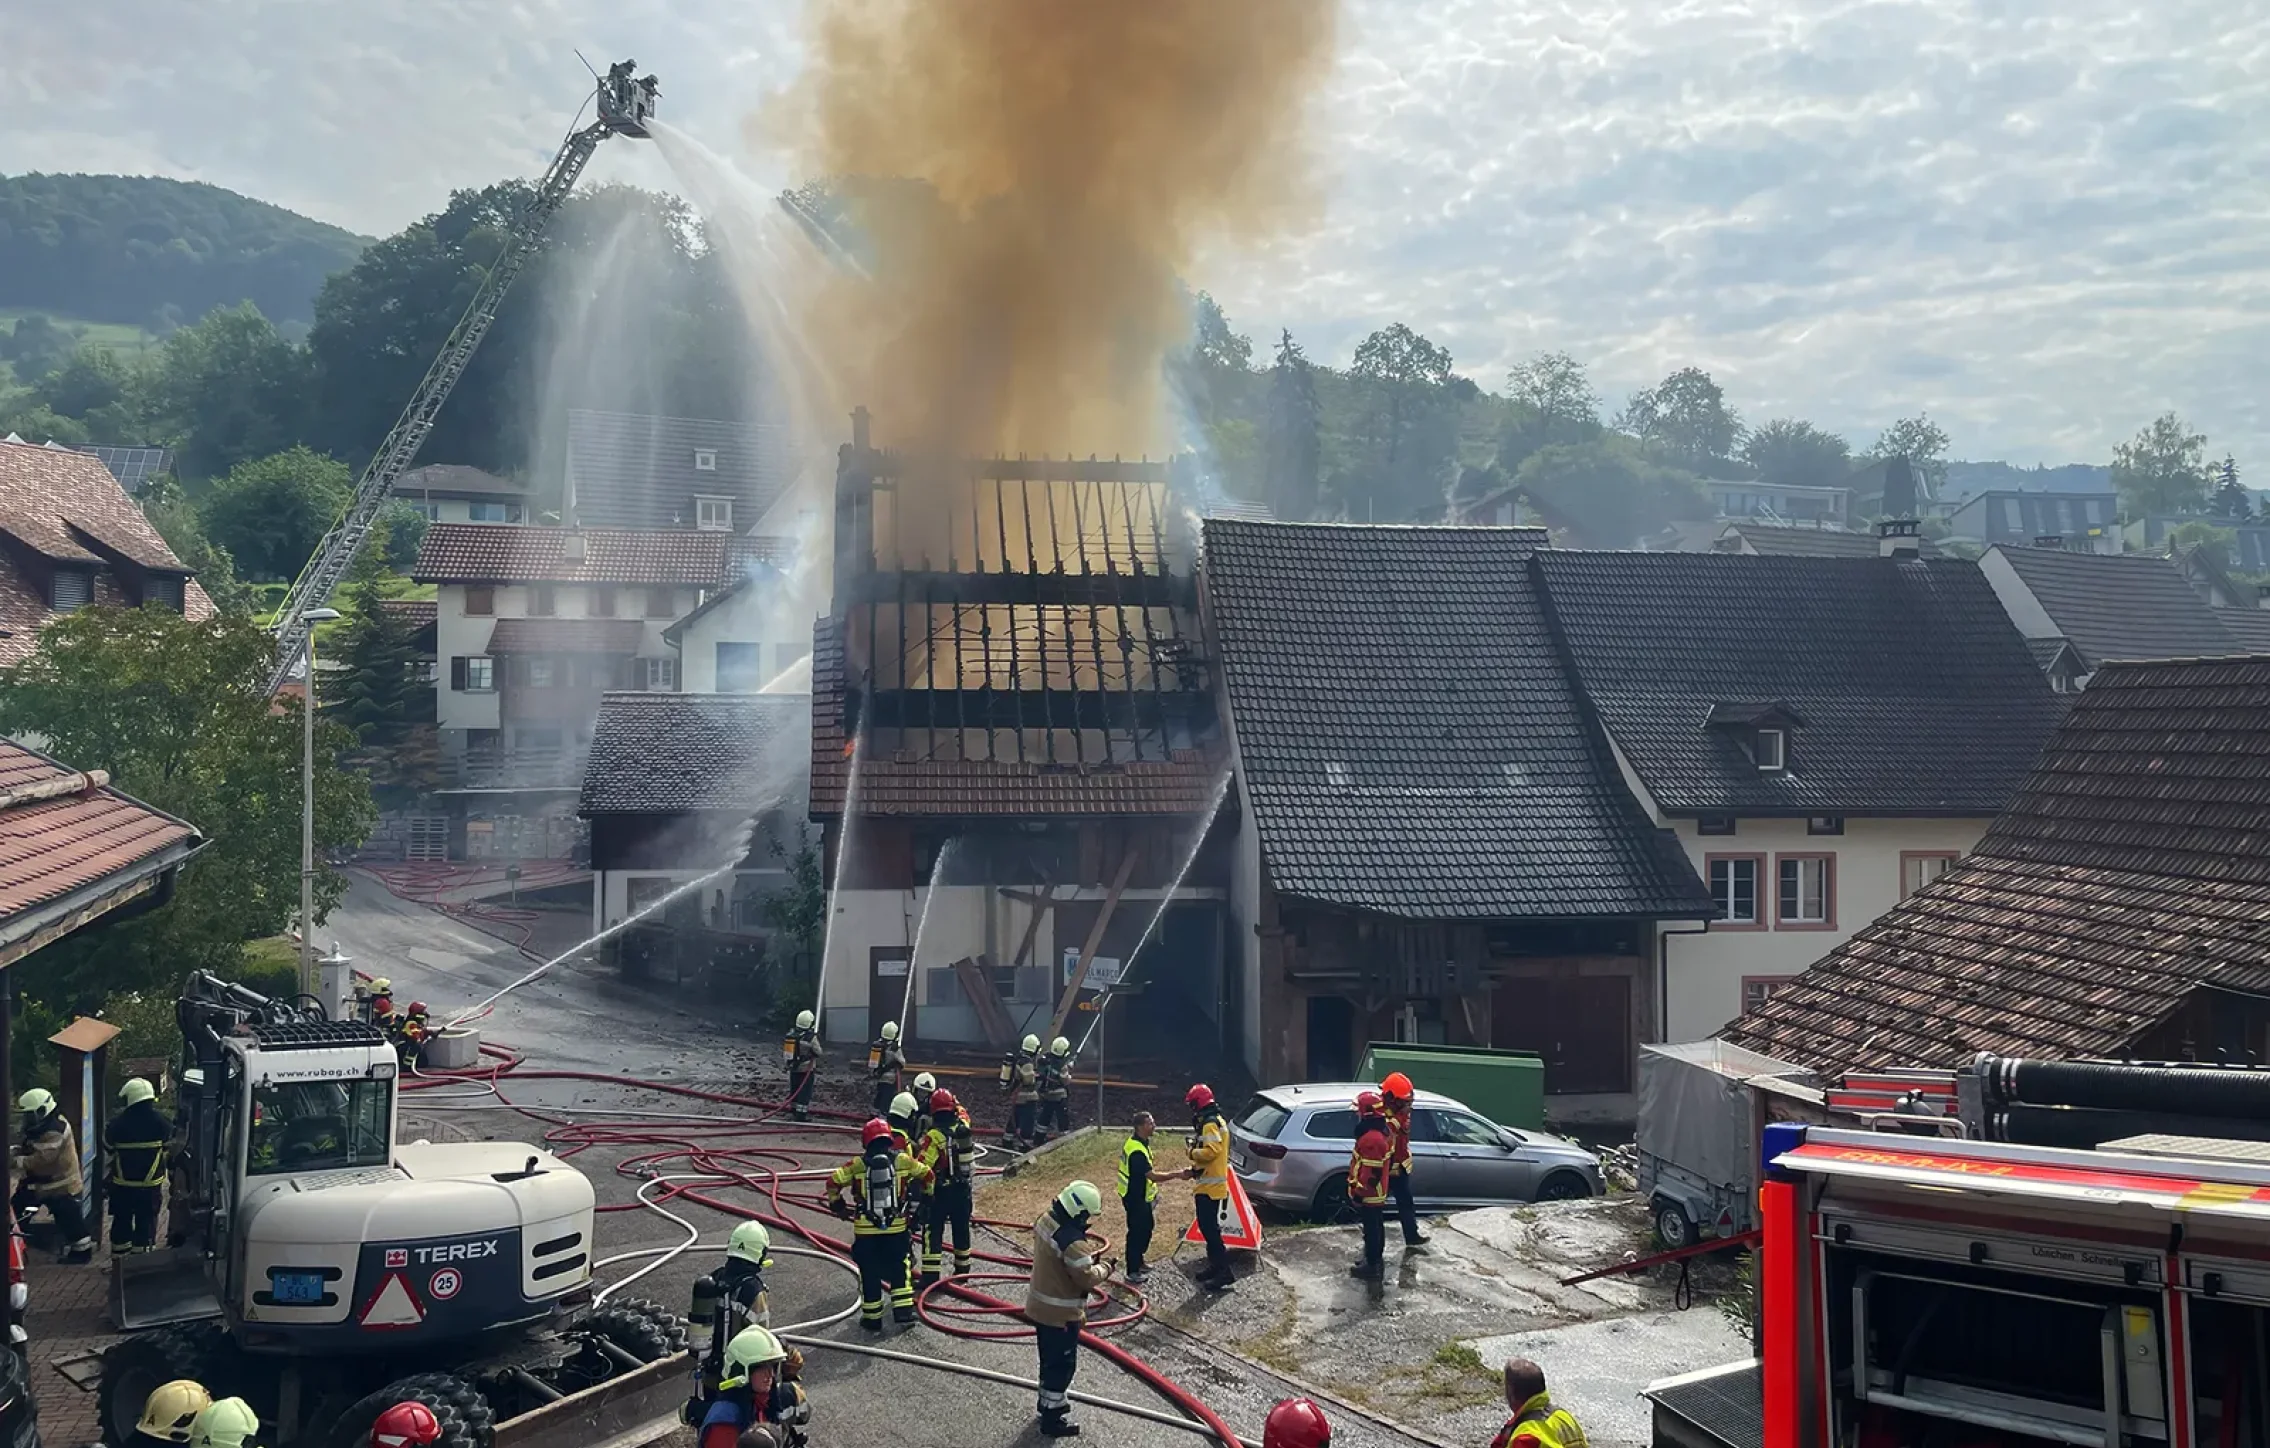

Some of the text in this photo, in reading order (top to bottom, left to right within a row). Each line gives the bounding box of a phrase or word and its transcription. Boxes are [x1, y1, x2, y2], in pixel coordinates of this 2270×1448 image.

[276, 1067, 359, 1078] www.rubag.ch
[414, 1240, 498, 1264] TEREX
[2032, 1246, 2075, 1261] Löschen
[436, 1276, 453, 1290] 25
[147, 1413, 156, 1426] A
[202, 1435, 211, 1446] A
